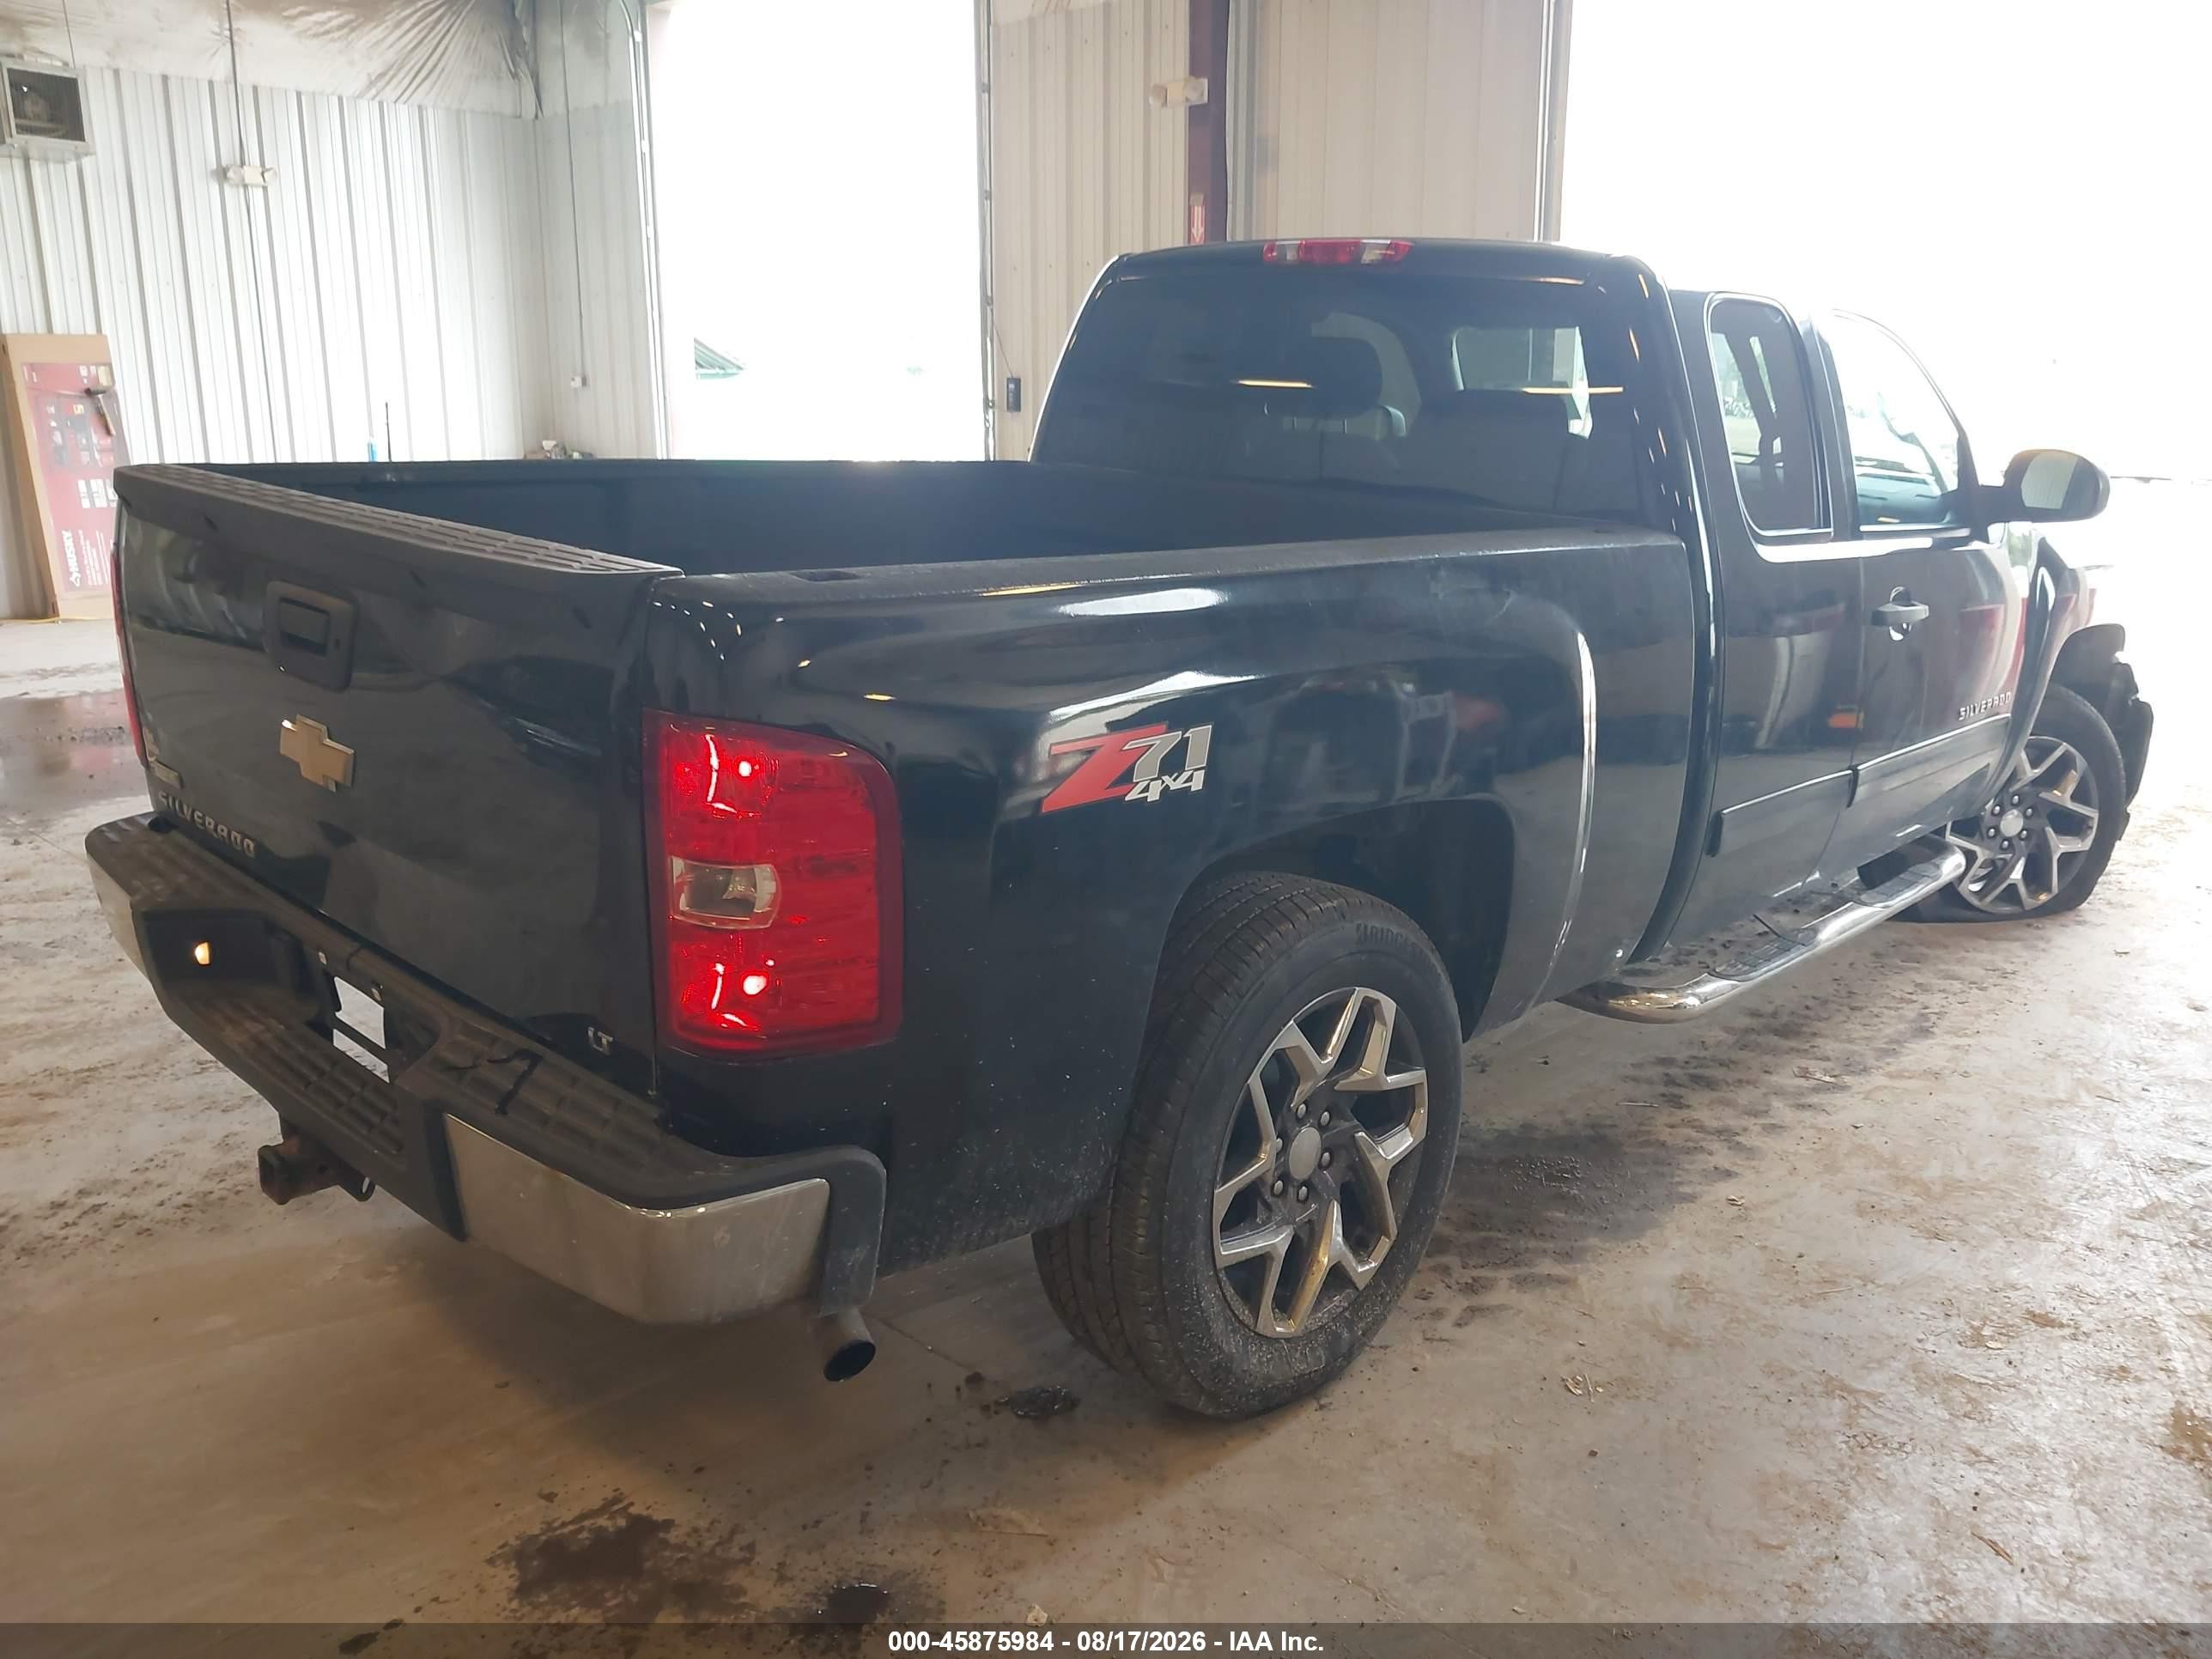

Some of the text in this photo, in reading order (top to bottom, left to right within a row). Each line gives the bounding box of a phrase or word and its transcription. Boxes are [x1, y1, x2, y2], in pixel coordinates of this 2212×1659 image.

[1959, 691, 2011, 720] SILVERADO
[1042, 723, 1212, 812] Z71
[158, 790, 255, 858] SILVERADO
[587, 1026, 613, 1055] LT
